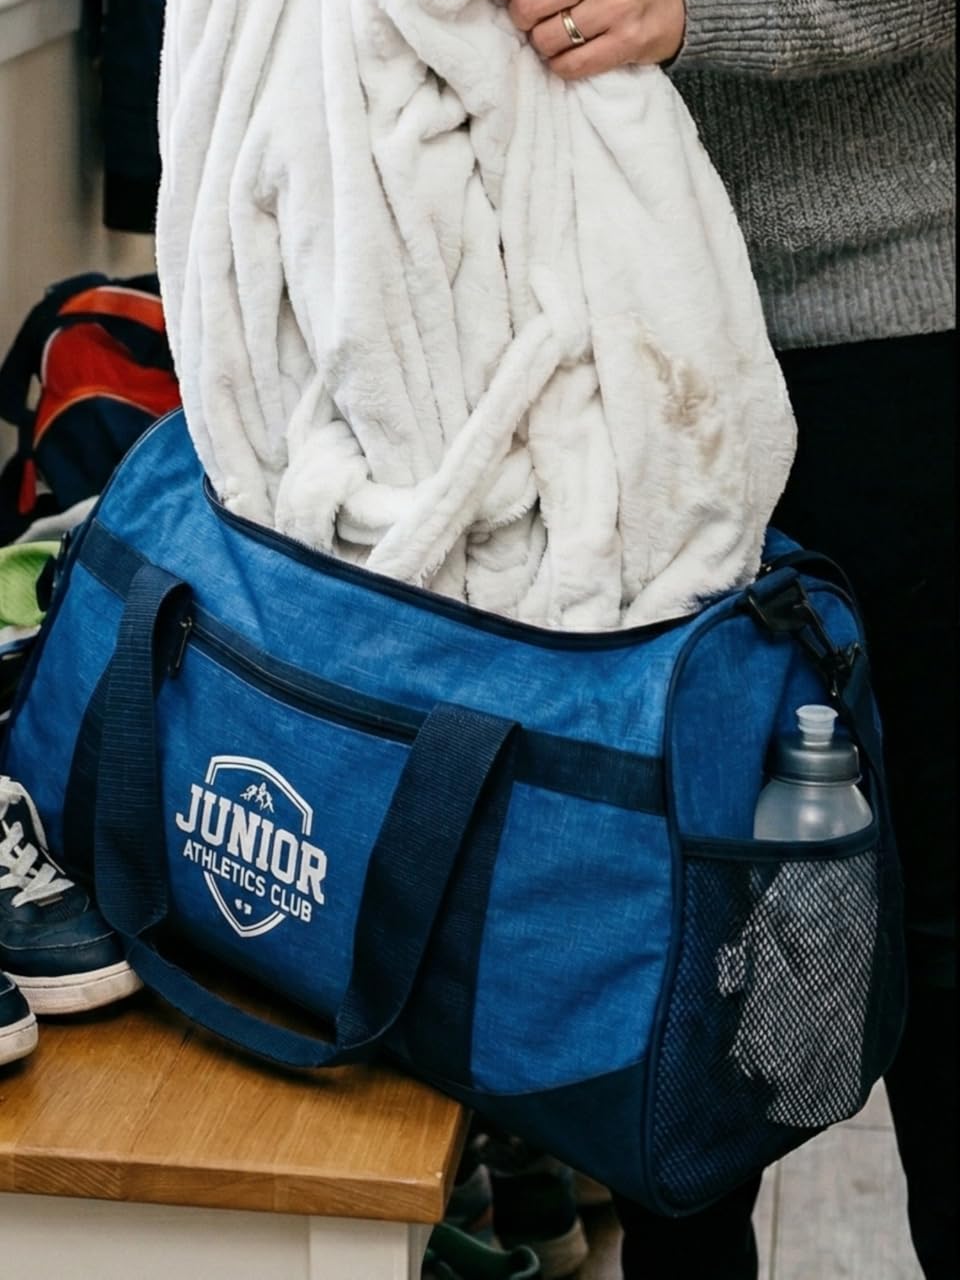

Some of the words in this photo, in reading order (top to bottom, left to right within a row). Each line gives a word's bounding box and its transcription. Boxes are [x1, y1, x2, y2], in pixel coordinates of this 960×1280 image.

[176, 783, 327, 905] JUNIOR
[183, 839, 266, 897] ATHLETICS
[270, 884, 312, 923] CLUB
